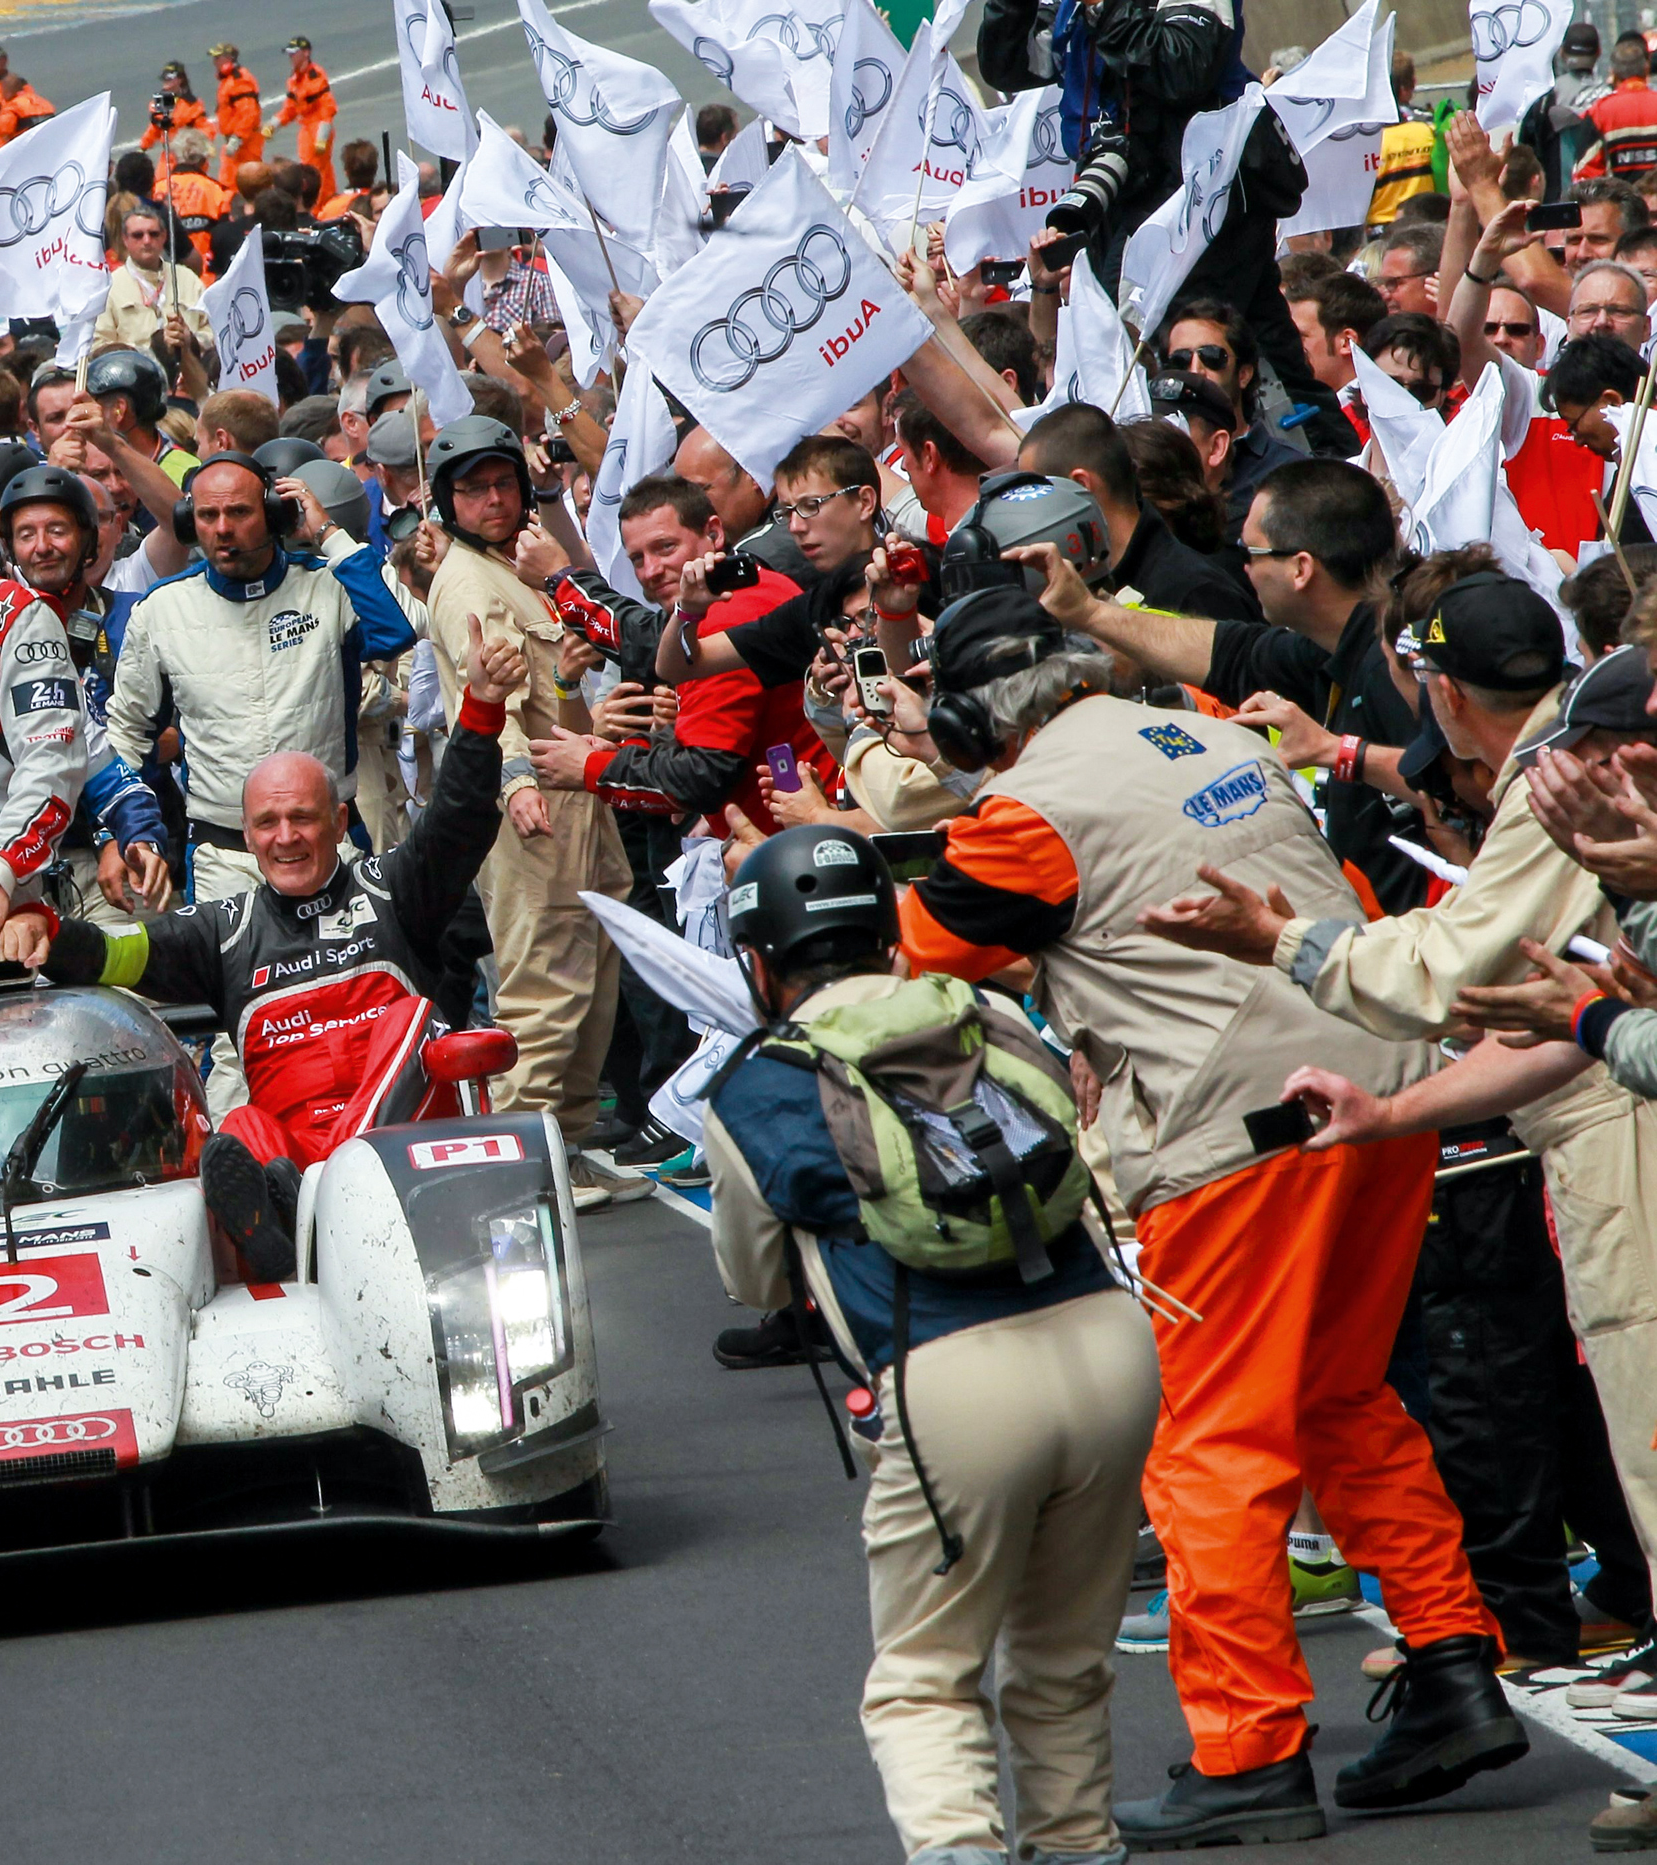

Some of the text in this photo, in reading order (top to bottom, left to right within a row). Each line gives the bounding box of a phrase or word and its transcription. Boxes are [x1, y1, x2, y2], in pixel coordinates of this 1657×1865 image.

[268, 613, 313, 635] EUROPEAN
[270, 617, 320, 644] LE MANS
[271, 635, 304, 653] SERIES
[30, 699, 65, 709] LE MANS
[1188, 770, 1264, 817] LE MANS
[274, 935, 376, 978] Audi Sport
[261, 1009, 312, 1037] Audi
[265, 1032, 305, 1049] Top
[430, 1139, 502, 1162] P1
[18, 1228, 96, 1244] MANS
[1287, 1537, 1320, 1551] PUMA
